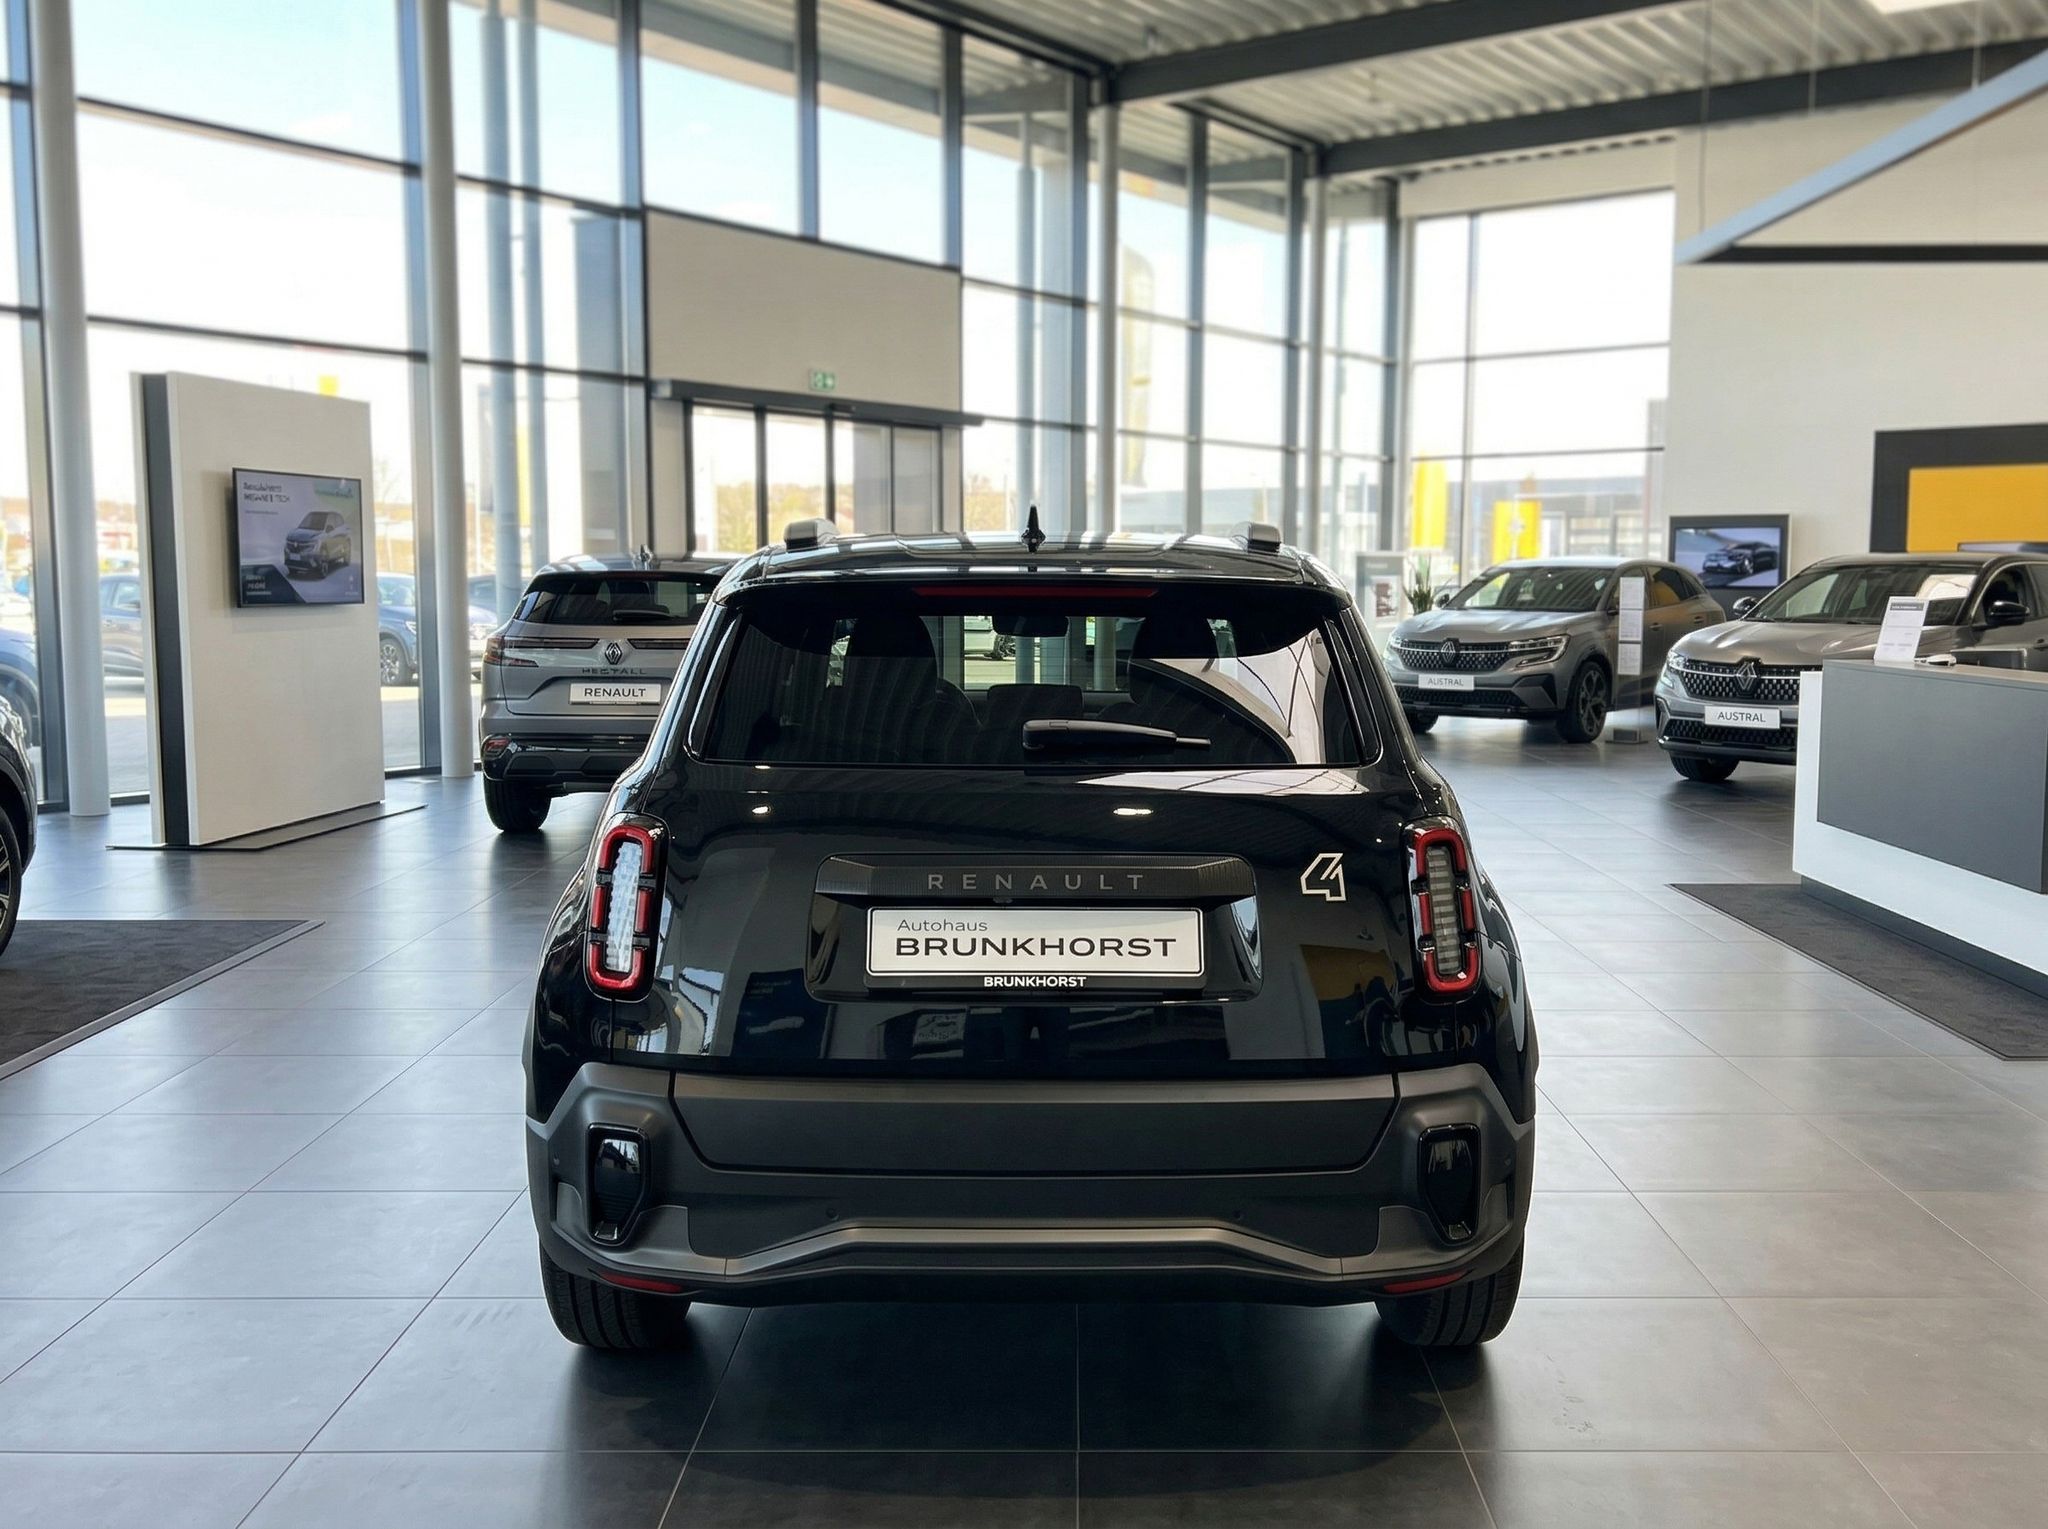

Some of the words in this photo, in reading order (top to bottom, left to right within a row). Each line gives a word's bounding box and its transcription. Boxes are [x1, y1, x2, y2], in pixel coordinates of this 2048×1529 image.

[1428, 678, 1463, 687] AUSTRAL
[584, 687, 646, 698] RENAULT
[1717, 711, 1766, 723] AUSTRAL
[928, 874, 1143, 889] RENAULT
[897, 918, 988, 932] Autohaus
[896, 937, 1177, 957] BRUNKHORST
[984, 976, 1087, 987] BRUNKHORST
